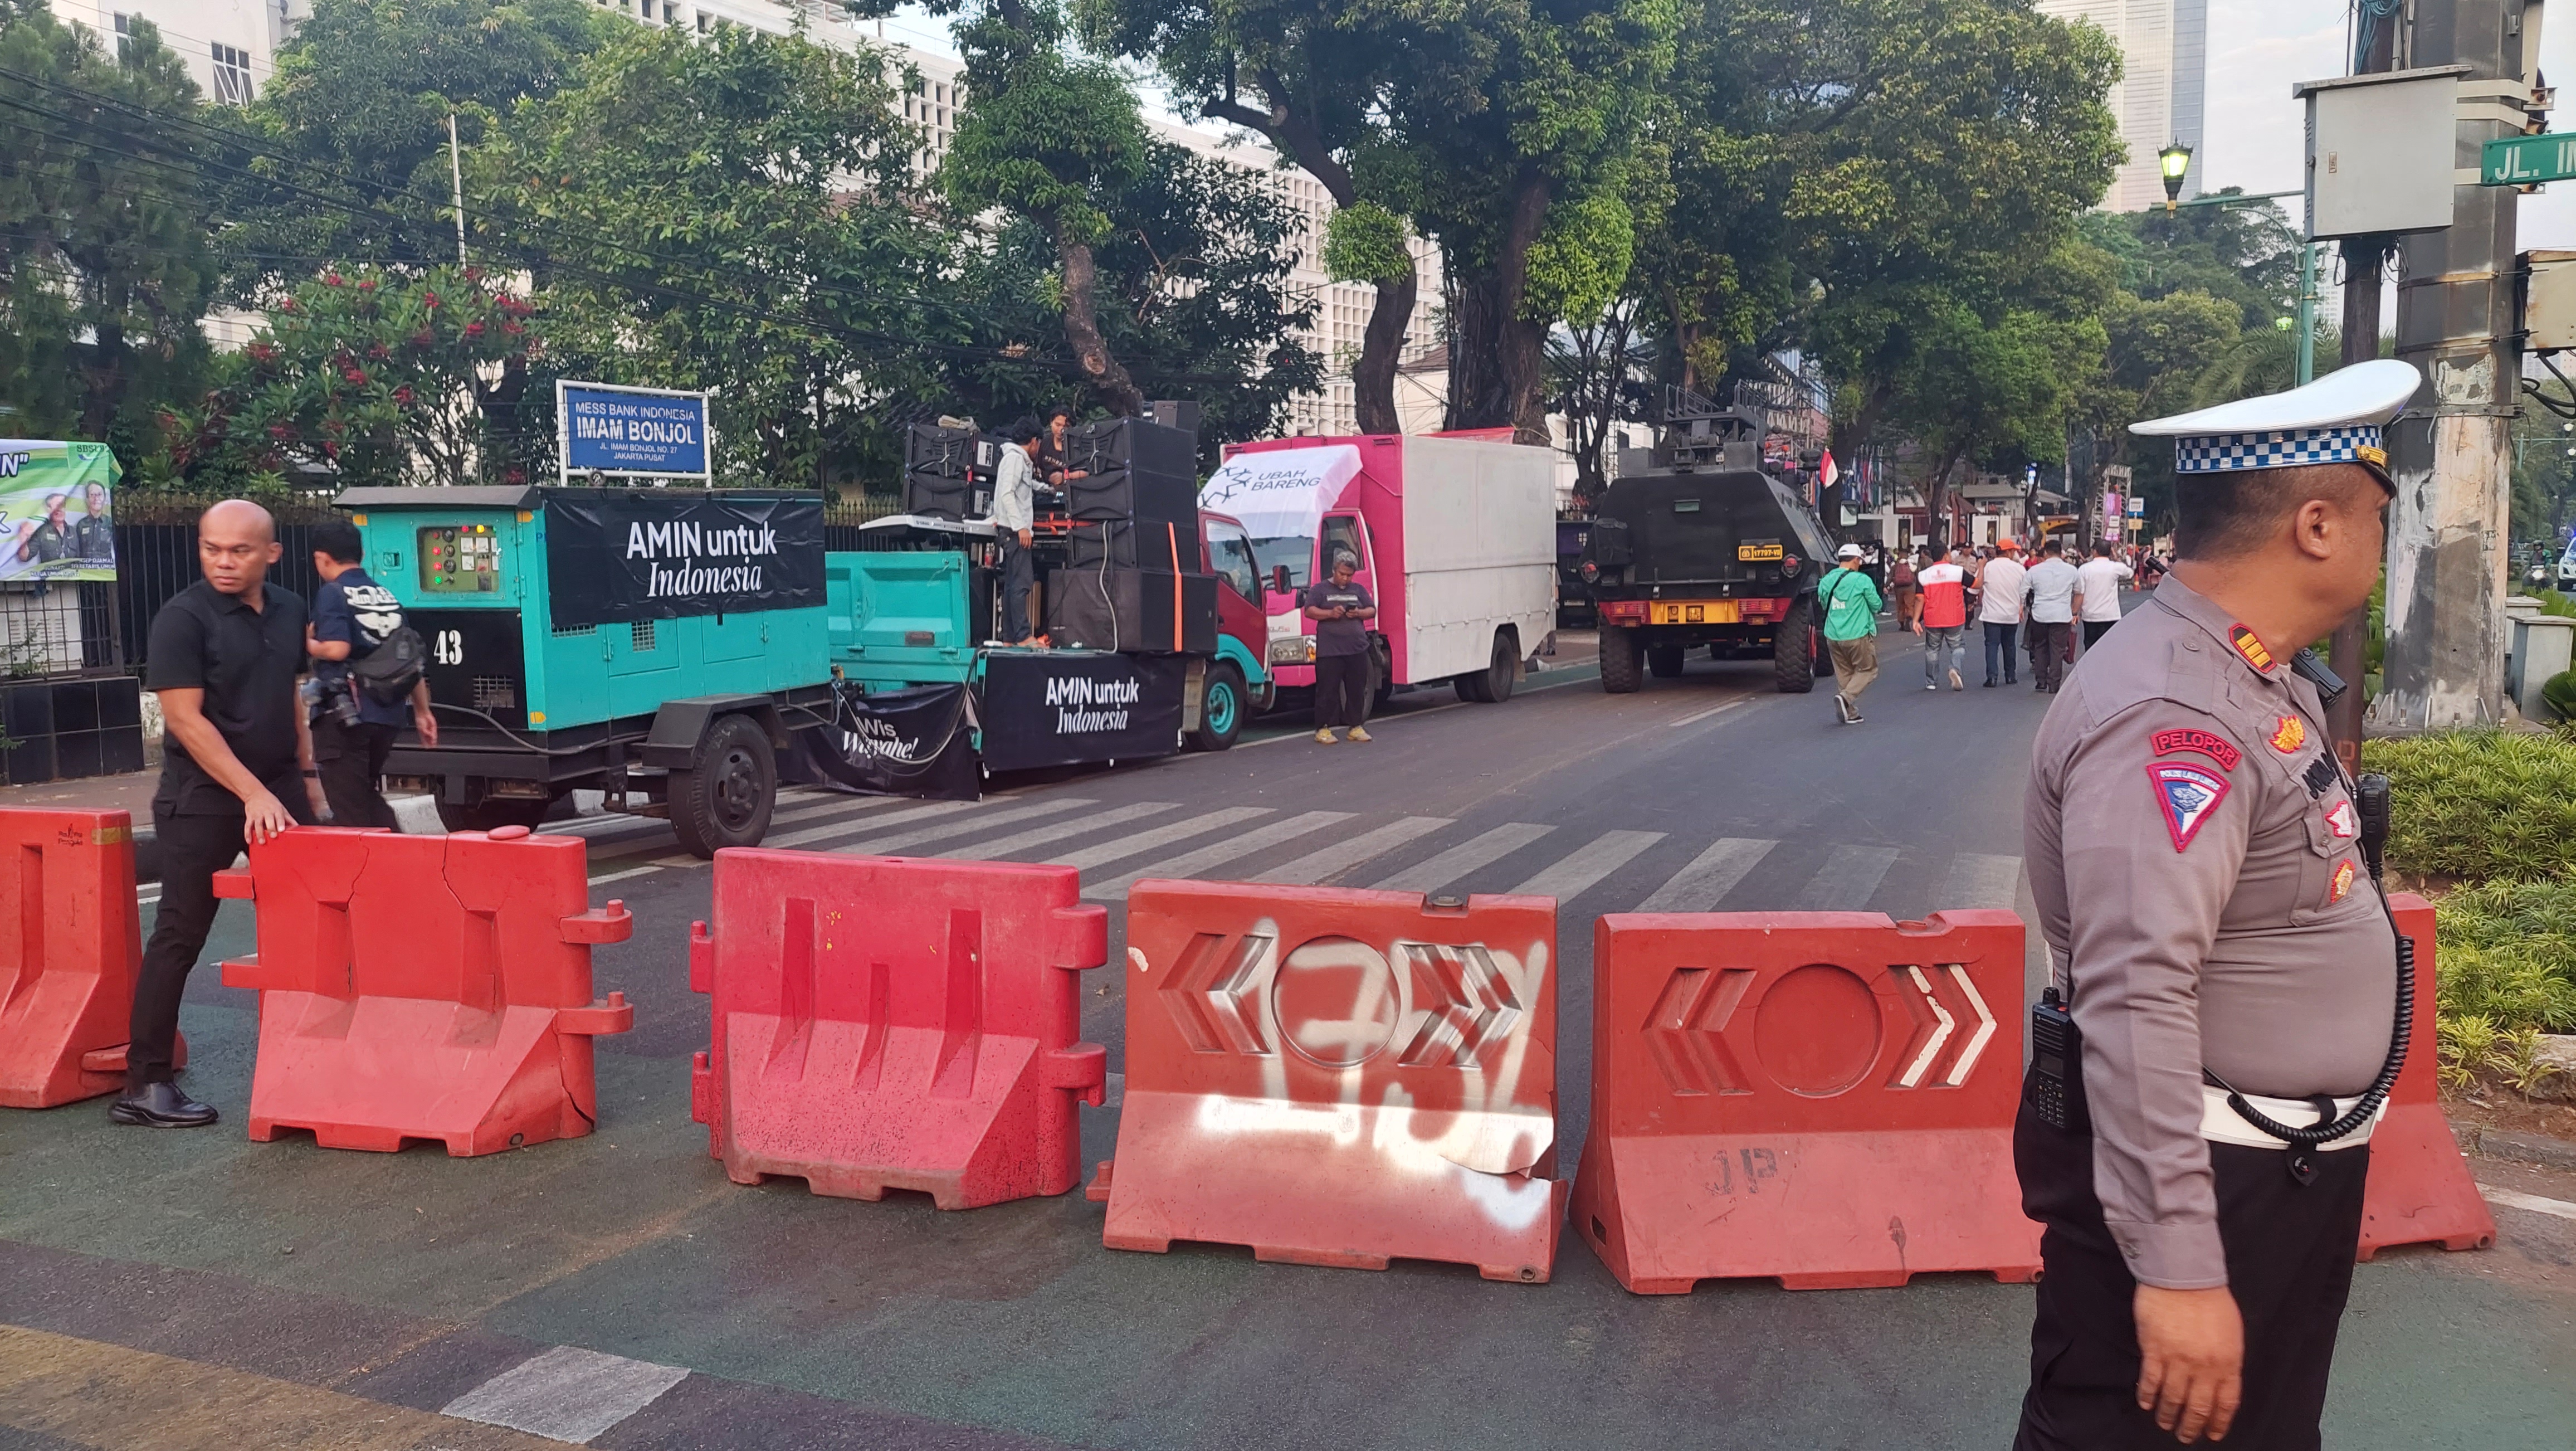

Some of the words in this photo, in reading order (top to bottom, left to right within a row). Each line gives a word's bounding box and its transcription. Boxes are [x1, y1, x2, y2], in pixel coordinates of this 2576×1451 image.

[2495, 146, 2539, 181] JL.
[575, 402, 606, 415] MESS
[609, 403, 638, 417] BANK
[641, 406, 695, 421] INDONESIA
[577, 416, 623, 440] IMAM
[628, 420, 697, 445] BONJOL
[599, 442, 609, 450] JL.
[611, 442, 628, 451] IMAM
[630, 444, 656, 452] BONJOL
[613, 452, 643, 461] JAKARTA
[644, 454, 665, 462] PUSAT
[1251, 477, 1321, 491] BARENG
[1258, 469, 1307, 480] UBAH
[626, 521, 701, 559] AMIN
[707, 520, 778, 557] untuk
[646, 556, 762, 597] Indonesia
[433, 630, 463, 665] 43
[1045, 676, 1092, 706] AMIN
[1095, 675, 1139, 704] untuk
[856, 717, 896, 737] Wis
[1056, 703, 1128, 734] Indonesia
[2157, 731, 2236, 765] PELOPOR
